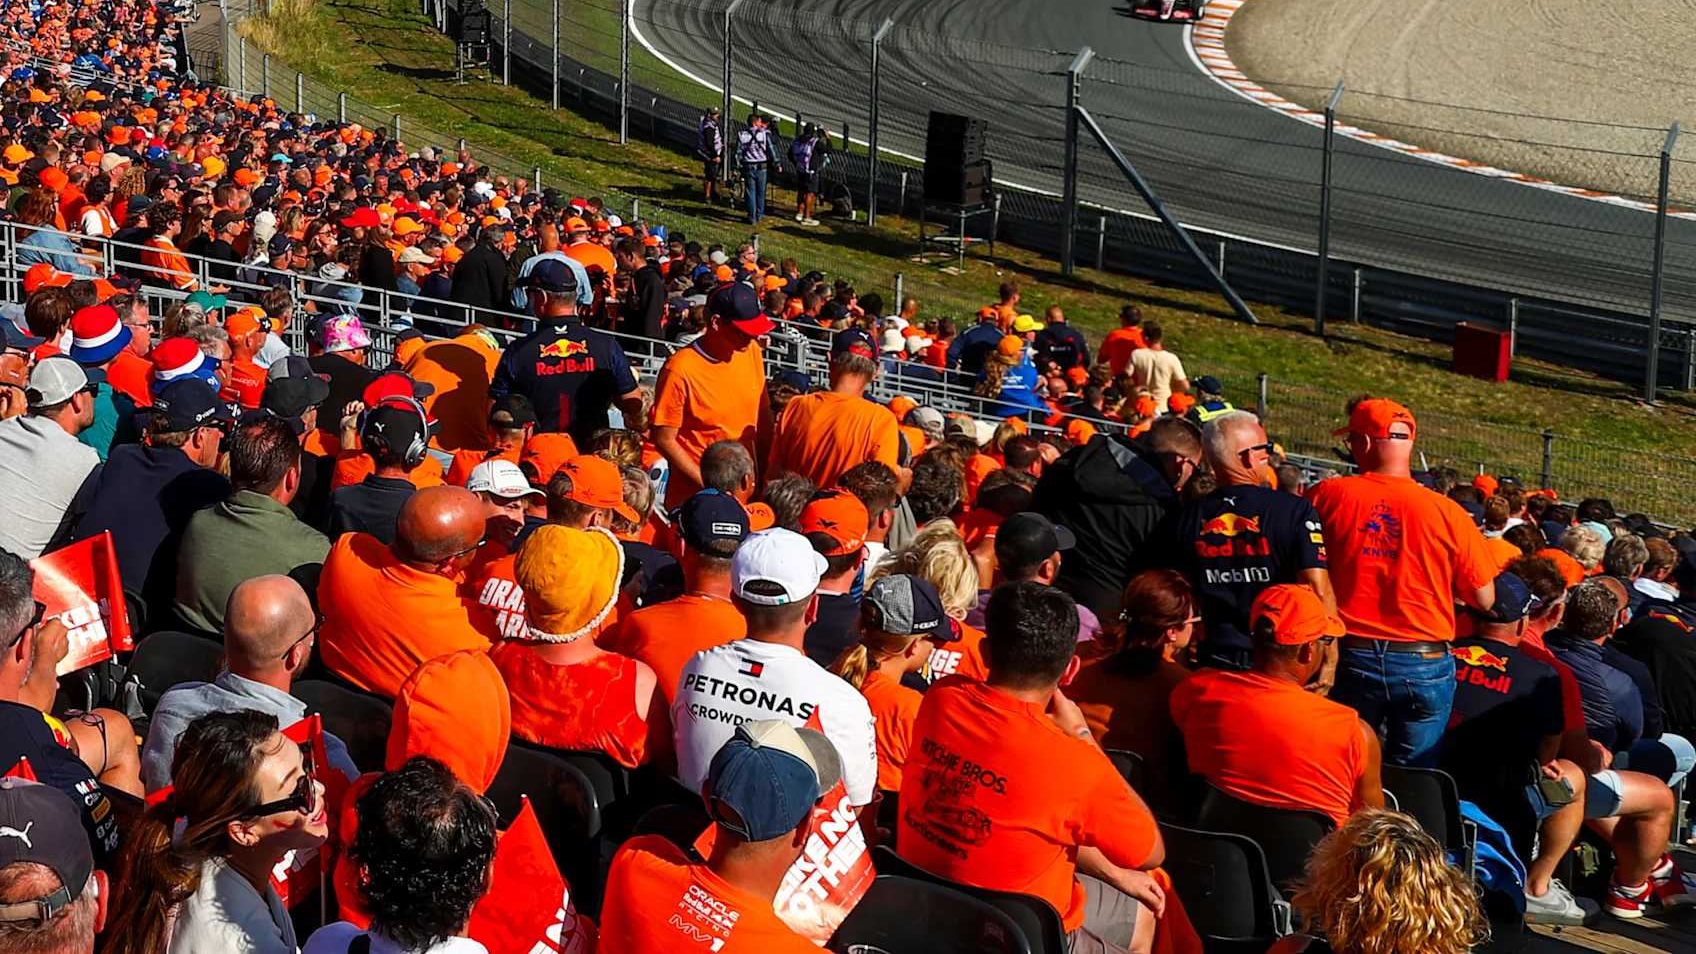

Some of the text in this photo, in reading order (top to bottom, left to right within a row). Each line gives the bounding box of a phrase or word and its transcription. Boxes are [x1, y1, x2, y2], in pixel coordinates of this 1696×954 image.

[535, 357, 595, 376] Red Bull
[1195, 539, 1233, 557] Red
[1362, 547, 1397, 559] KNVB
[1205, 567, 1250, 584] Mobil
[684, 673, 814, 720] PETRONAS
[1468, 667, 1511, 694] Bull
[920, 737, 1007, 796] RITCHIE BROS.
[820, 795, 856, 846] NO
[904, 809, 968, 861] Auctioneers
[683, 892, 713, 918] Red Bull
[688, 884, 740, 922] ORACLE
[677, 901, 731, 939] RACING
